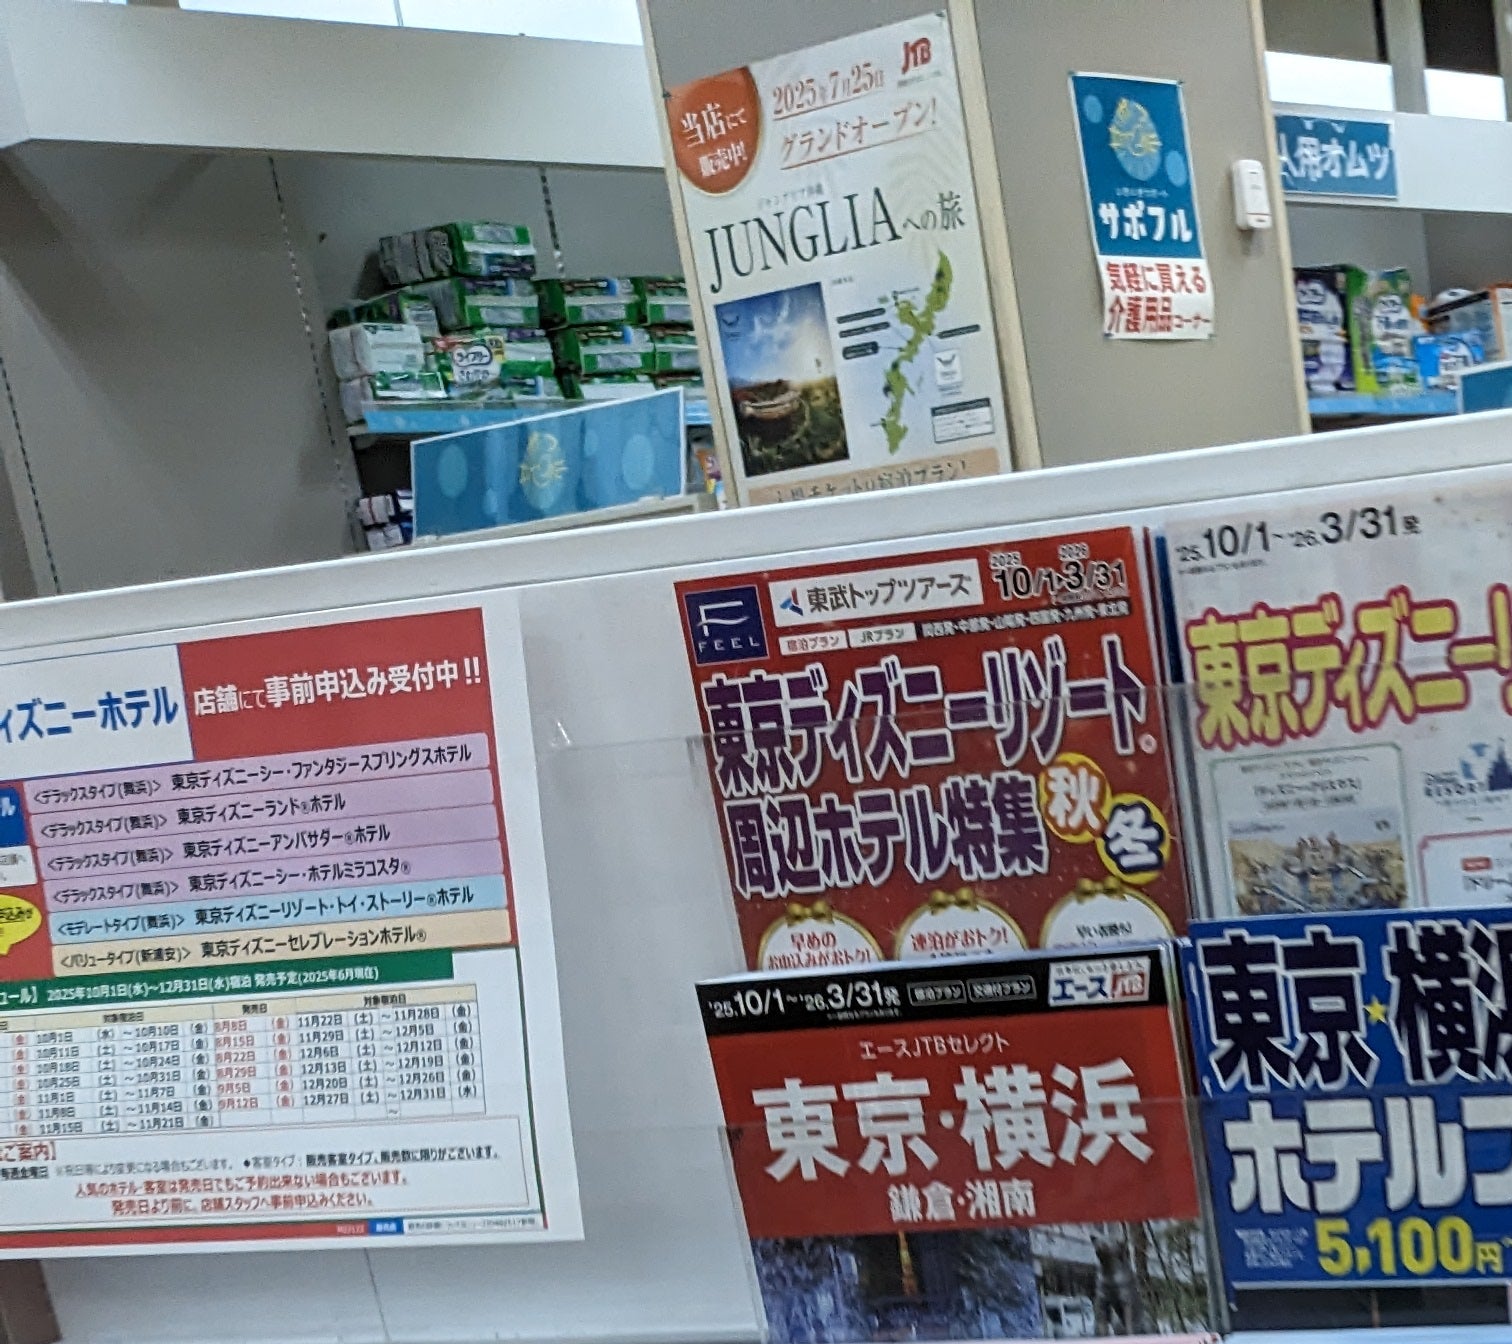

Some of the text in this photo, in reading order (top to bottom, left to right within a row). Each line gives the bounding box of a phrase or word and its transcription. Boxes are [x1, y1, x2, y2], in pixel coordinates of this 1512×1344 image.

[902, 38, 931, 74] JTB
[681, 102, 748, 147] 当店にて
[781, 98, 936, 162] グランドオープン!
[1099, 201, 1192, 243] サポフル
[1104, 262, 1207, 294] 気軽に買える
[1108, 296, 1211, 333] 介護用品コーナー
[807, 573, 972, 613] 東武トップツアーズ
[698, 636, 760, 654] FEEL
[0, 657, 482, 743] ィズニーホテル 店舗にて事前申込み受付中!!
[702, 633, 1147, 798] 東京ディズニーリゾート
[171, 744, 471, 793] 東京ディズニーシー・ファンタジースプリングスホテル
[723, 771, 1048, 899] 周辺ホテル特集
[1046, 767, 1164, 871] 秋 冬
[790, 931, 836, 948] 早めの
[1051, 973, 1145, 1001] エース JTB
[1199, 923, 1380, 1092] 東京
[859, 1035, 1009, 1061] エースJTBセレクト
[752, 1058, 1154, 1183] 東京・横浜
[888, 1178, 1037, 1223] 鎌倉・湘南
